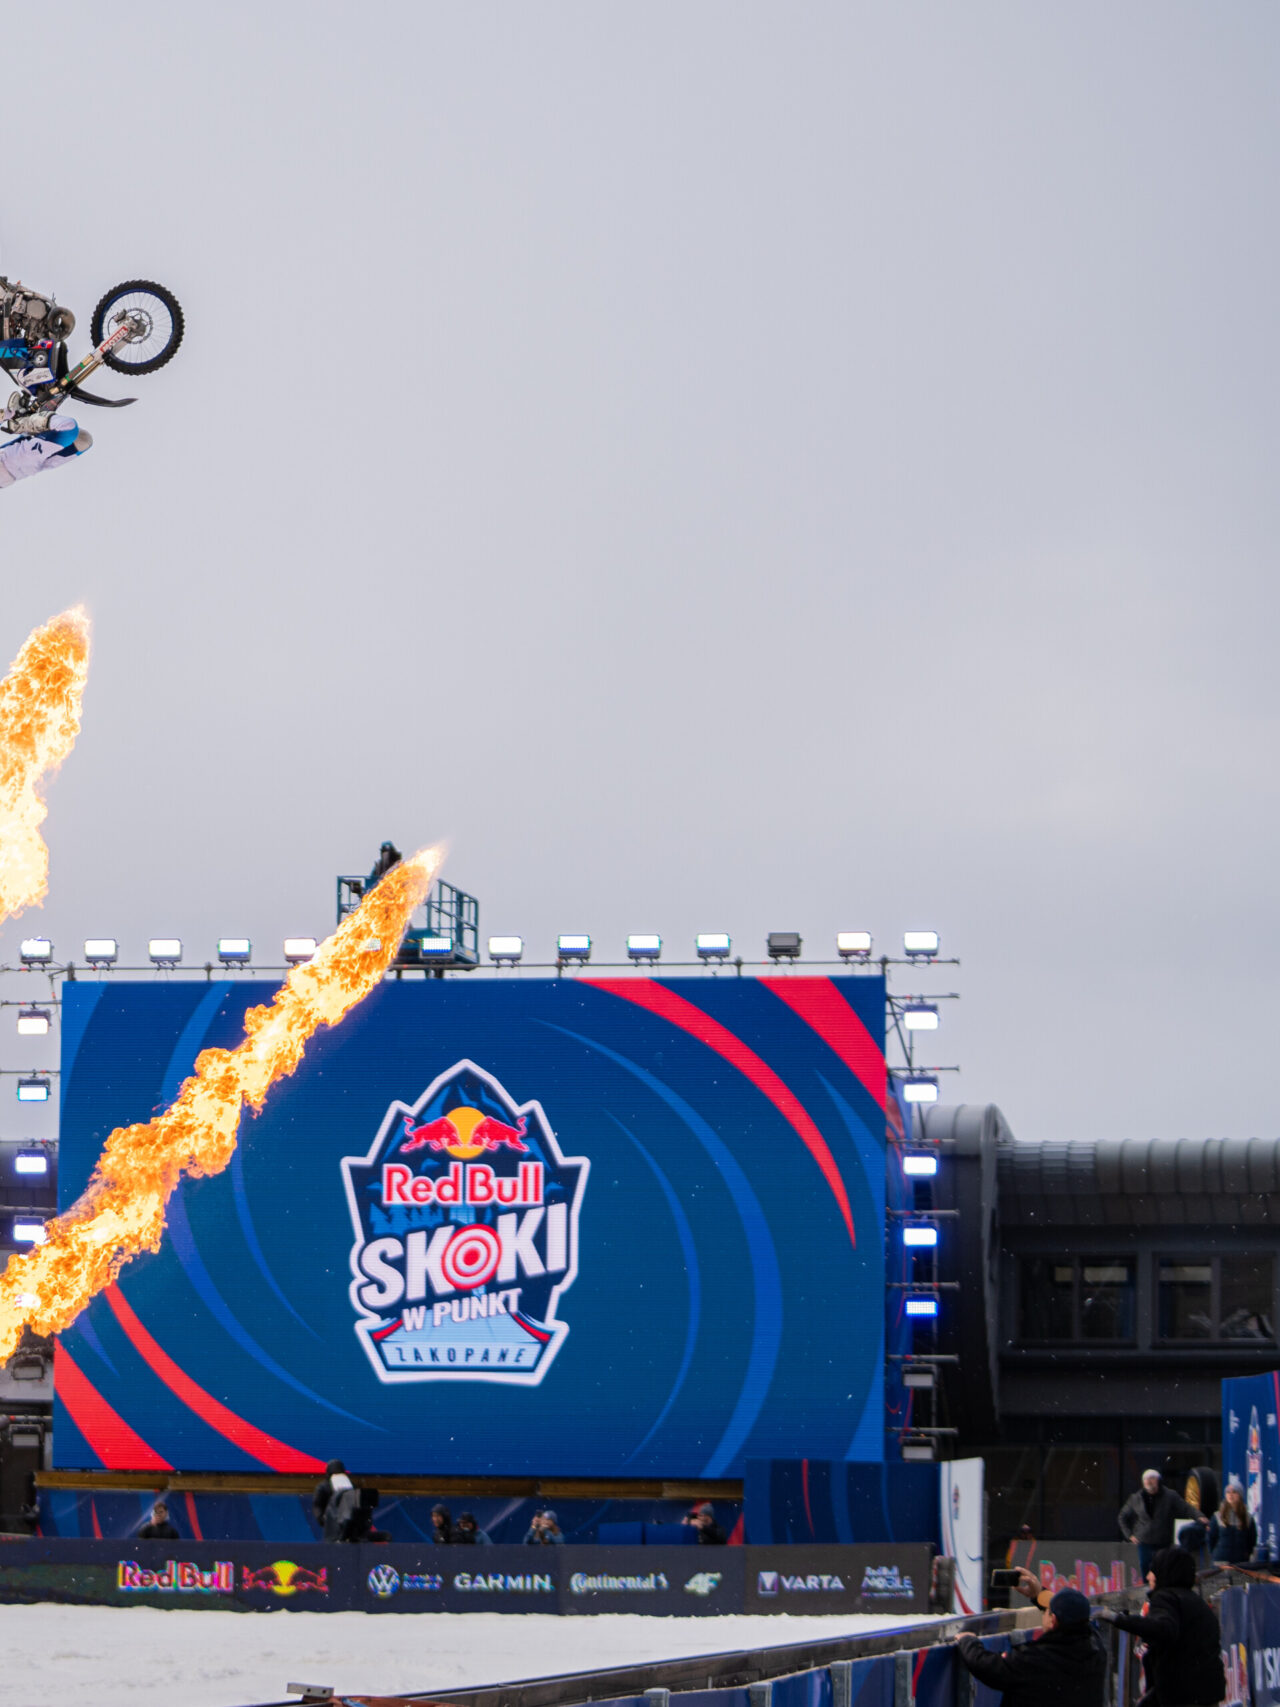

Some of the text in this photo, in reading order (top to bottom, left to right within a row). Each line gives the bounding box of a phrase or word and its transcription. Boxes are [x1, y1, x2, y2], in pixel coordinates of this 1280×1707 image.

[382, 1162, 544, 1206] Red Bull
[361, 1202, 567, 1307] SKOKI
[402, 1288, 522, 1332] W PUNKT
[395, 1346, 525, 1363] ZAKOPANE
[118, 1560, 234, 1592] Red Bull
[454, 1572, 554, 1592] GARMIN
[780, 1574, 846, 1591] VARTA
